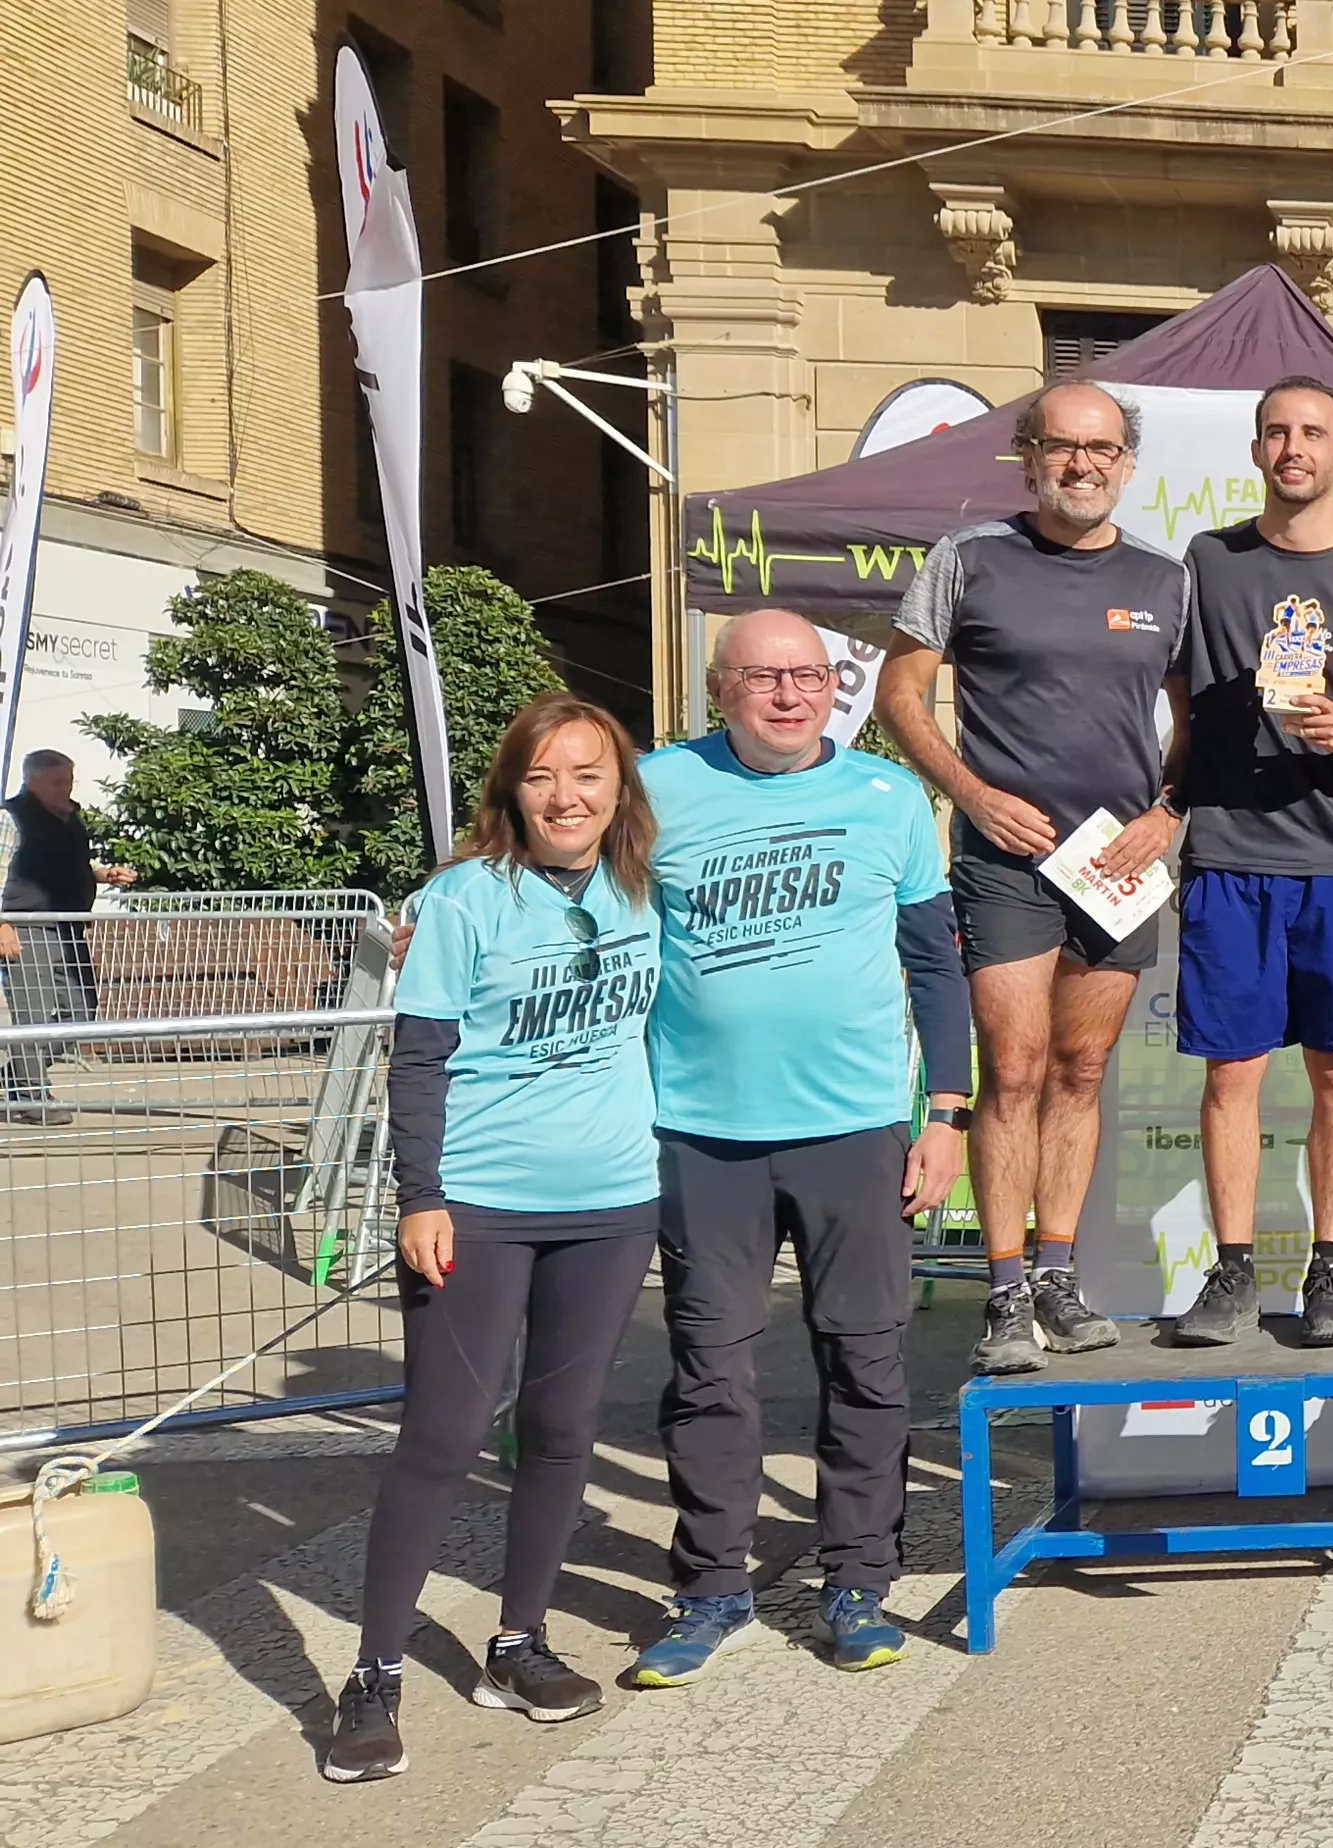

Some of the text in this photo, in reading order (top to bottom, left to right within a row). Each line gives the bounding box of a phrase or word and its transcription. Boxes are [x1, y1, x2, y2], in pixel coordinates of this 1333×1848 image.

[1273, 659, 1323, 672] EMPRESAS
[1266, 689, 1276, 705] 2
[701, 844, 812, 880] III CARRERA
[685, 860, 845, 932] EMPRESAS
[1070, 878, 1091, 896] 8K
[1078, 866, 1121, 906] MARTIN
[707, 915, 803, 946] ESIC HUESCA
[531, 964, 557, 990] III
[499, 966, 655, 1046] EMPRESAS
[530, 1040, 565, 1059] ESIC
[1249, 1409, 1293, 1468] 2
